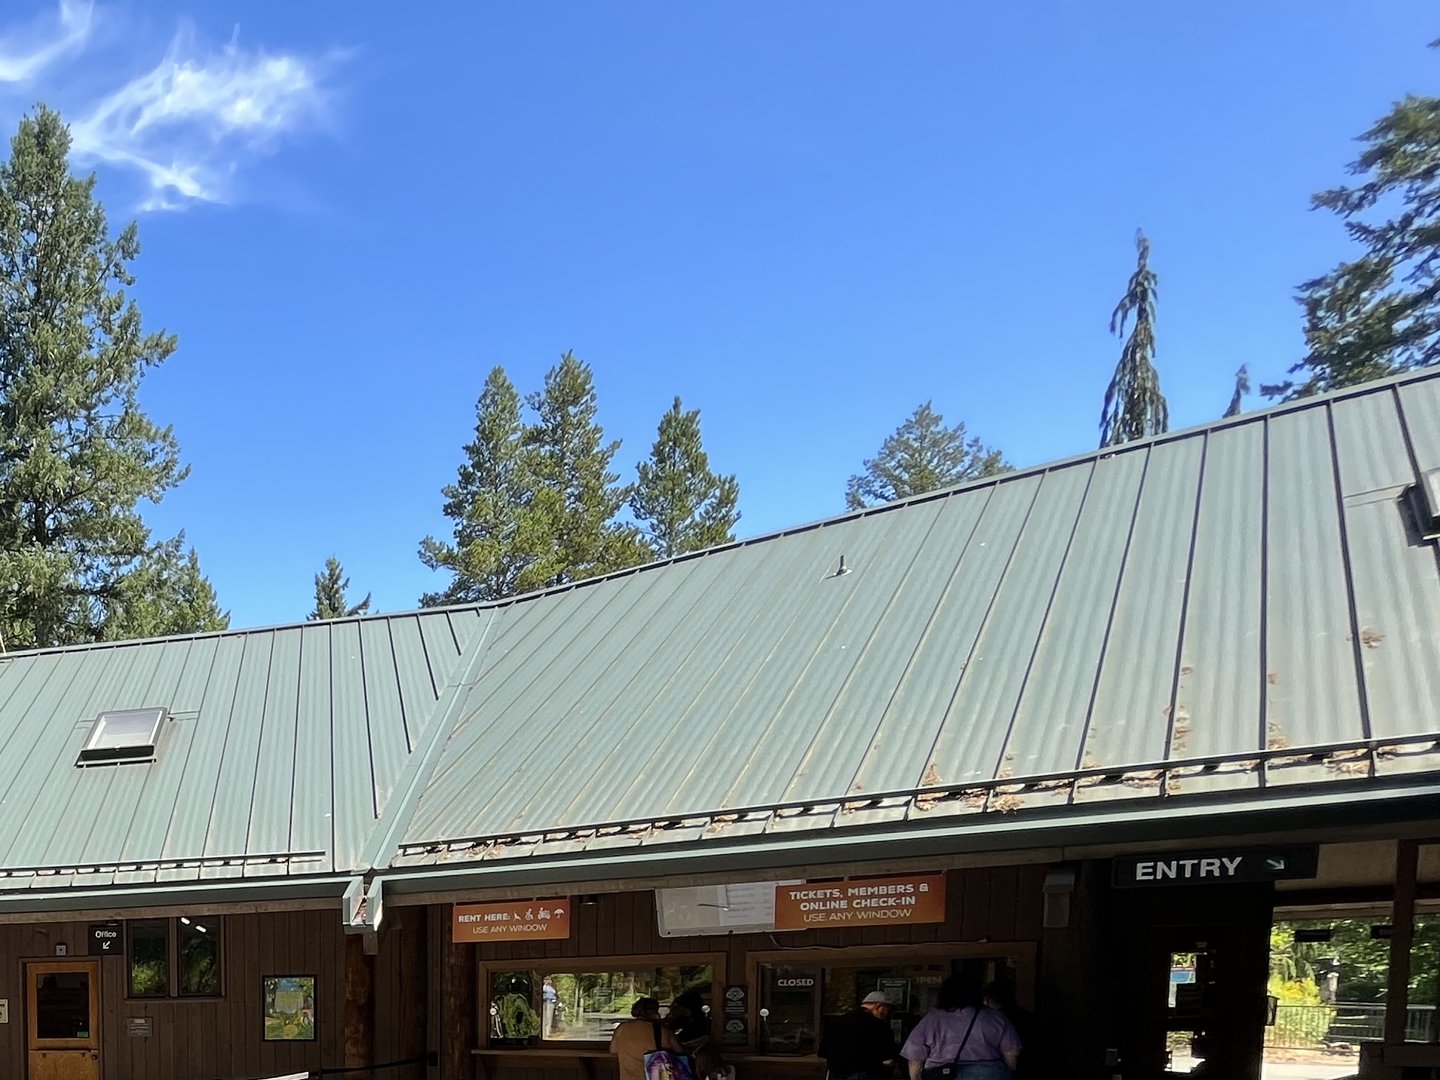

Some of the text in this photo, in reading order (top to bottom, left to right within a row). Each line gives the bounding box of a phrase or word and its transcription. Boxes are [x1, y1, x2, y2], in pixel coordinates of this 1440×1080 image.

[1136, 856, 1243, 880] ENTRY
[789, 883, 929, 900] TICKETS, MEMBERS &
[800, 896, 916, 911] ONLINE CHECK-IN
[458, 914, 481, 923] RENT
[803, 908, 912, 922] USE ANY WINDOW
[95, 930, 117, 938] Office
[472, 923, 547, 934] USE ANY WINDOW
[777, 978, 814, 987] CLOSED
